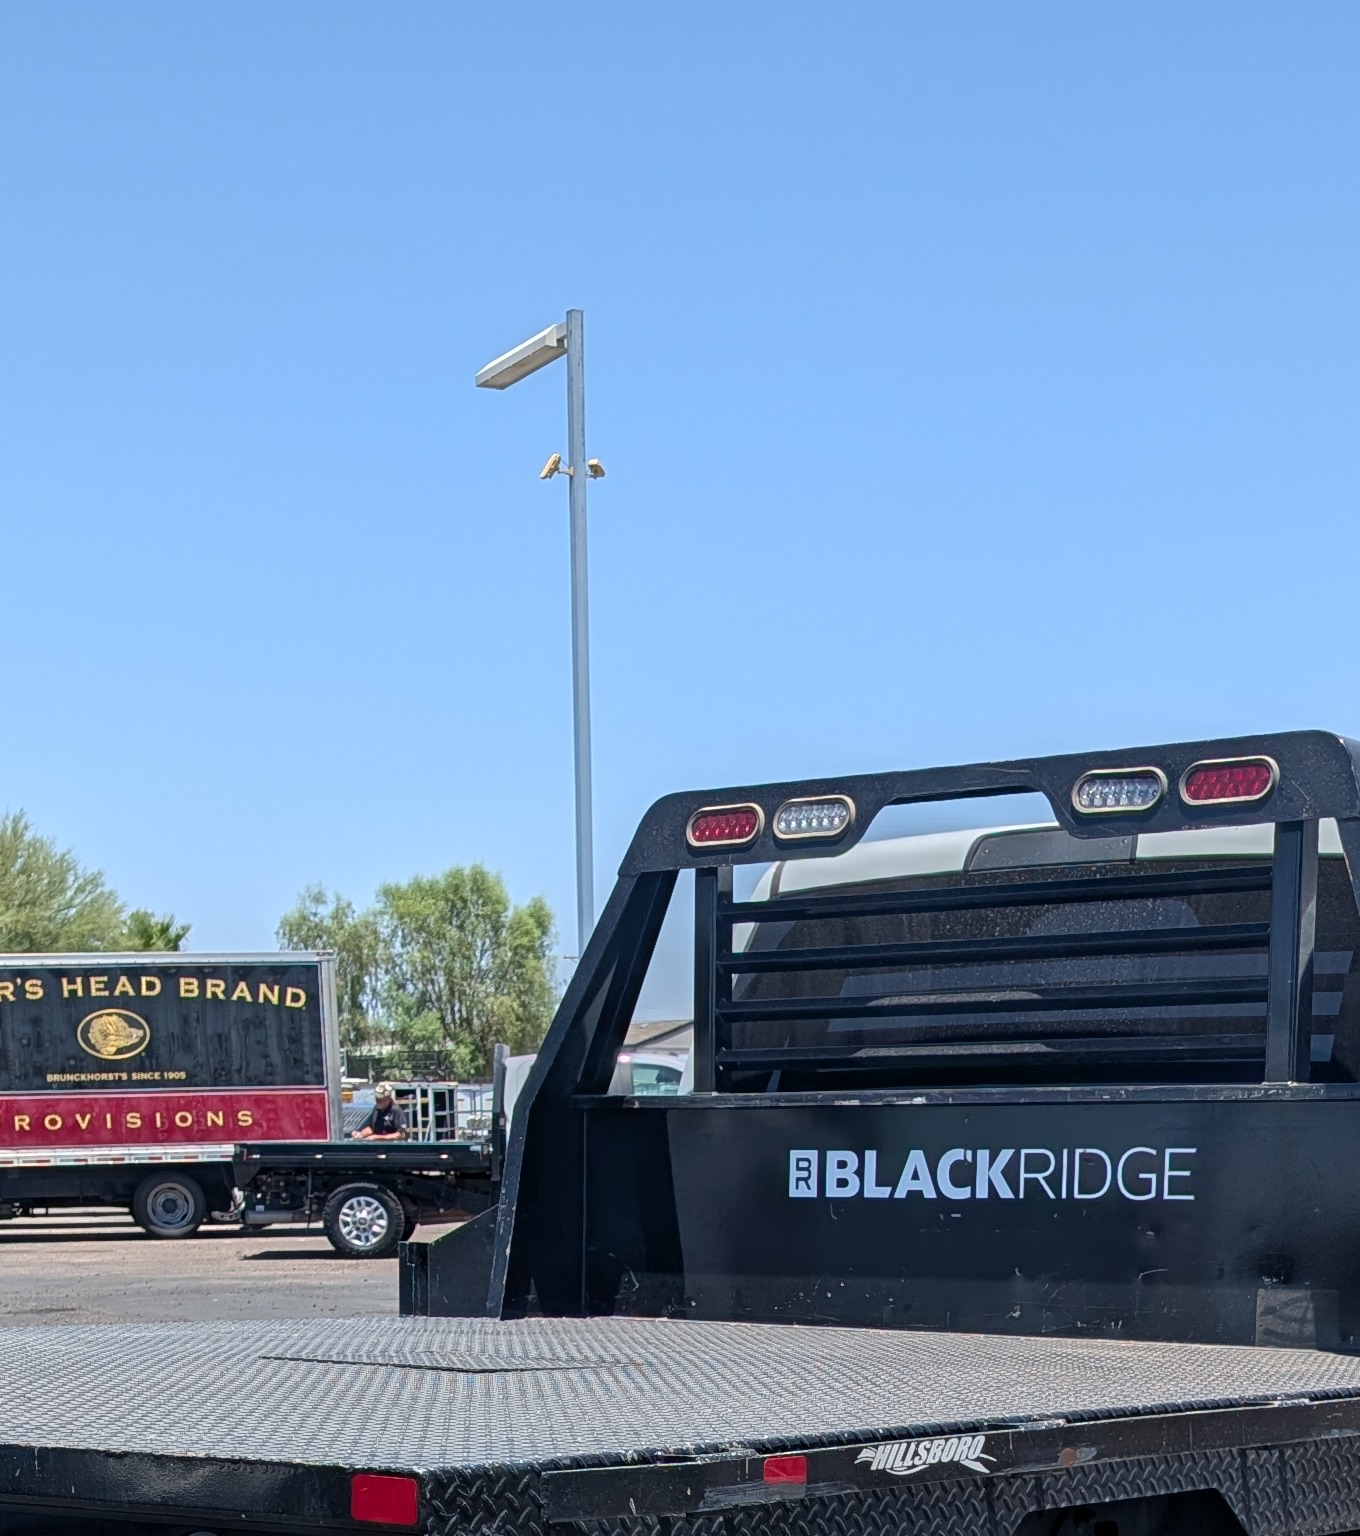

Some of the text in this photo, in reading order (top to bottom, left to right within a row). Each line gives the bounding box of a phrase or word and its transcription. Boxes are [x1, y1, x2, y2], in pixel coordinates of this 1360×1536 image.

[62, 975, 162, 999] HEAD
[178, 976, 307, 1010] BRAND
[131, 1070, 162, 1082] SINCE
[163, 1070, 187, 1081] 1905
[825, 1146, 1197, 1201] BLACKRIDGE
[869, 1434, 987, 1471] HILLSBORO
